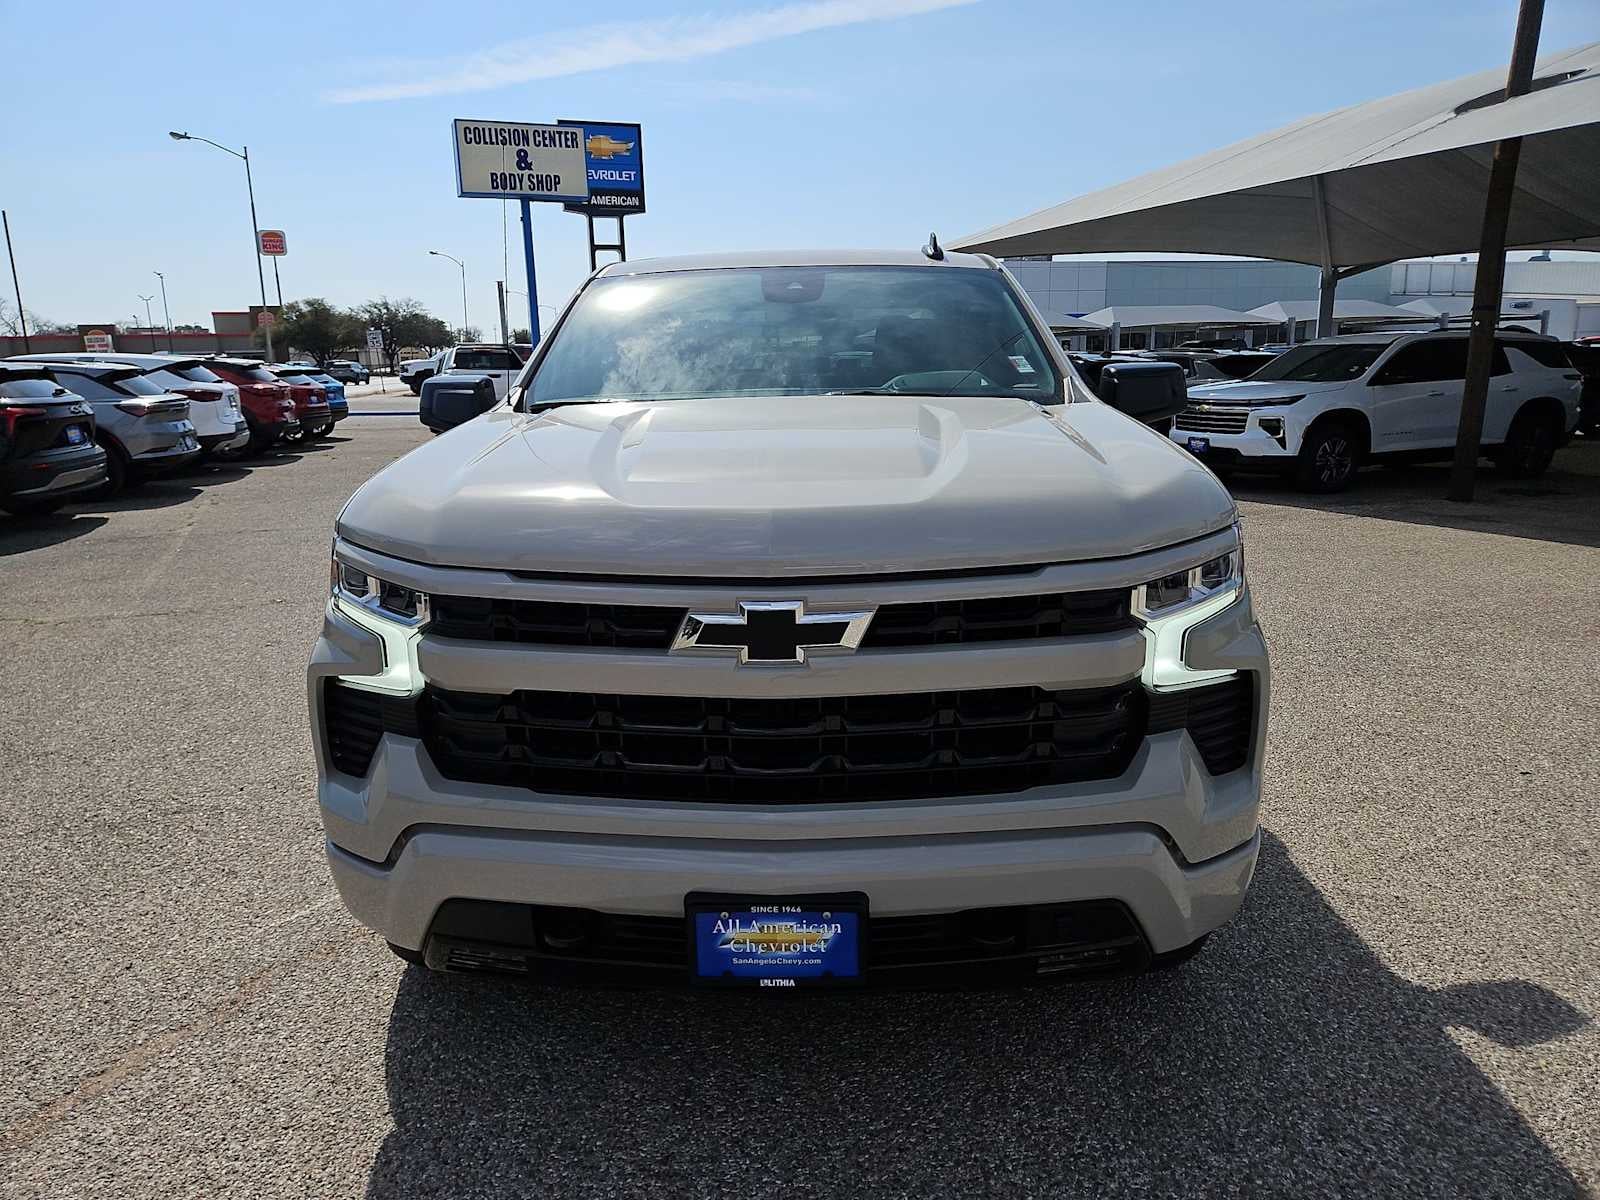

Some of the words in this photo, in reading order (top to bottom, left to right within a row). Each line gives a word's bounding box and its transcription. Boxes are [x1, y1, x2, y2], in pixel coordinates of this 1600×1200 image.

[463, 126, 531, 149] COLLISION
[533, 130, 579, 149] CENTER
[515, 148, 533, 172] &
[490, 172, 524, 191] BODY
[527, 173, 561, 192] SHOP
[587, 169, 637, 182] EVROLET
[590, 195, 640, 207] AMERICAN
[262, 242, 285, 251] KING
[750, 905, 779, 913] SINCE
[781, 905, 802, 913] 1946
[712, 919, 740, 934] All
[747, 919, 842, 934] American
[730, 938, 827, 954] Chevrolet
[732, 957, 822, 966] SanAngeloChevy.com
[767, 978, 796, 987] LITHIA
